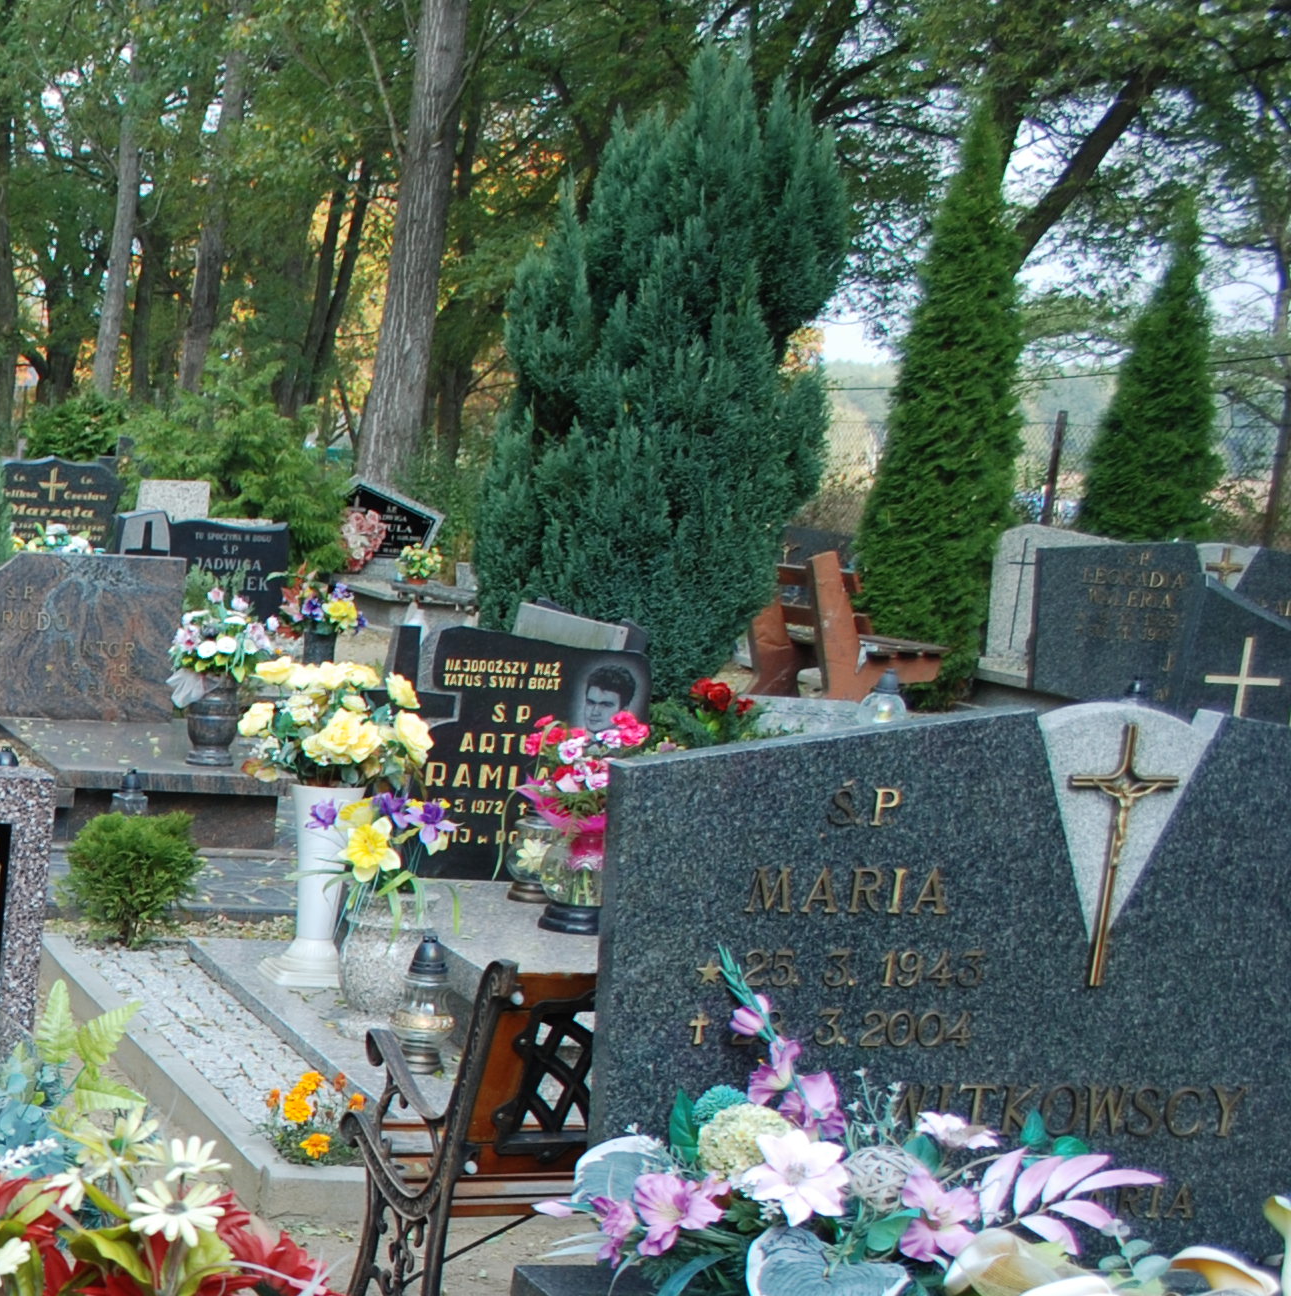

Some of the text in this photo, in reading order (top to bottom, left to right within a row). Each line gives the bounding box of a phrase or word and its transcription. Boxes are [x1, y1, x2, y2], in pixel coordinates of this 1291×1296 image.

[376, 514, 408, 523] ADWIGA
[527, 677, 563, 691] BRAT
[425, 761, 550, 791] RAMLA
[471, 799, 504, 815] 1972
[744, 866, 949, 916] MARIA
[880, 949, 986, 989] 1943
[859, 1009, 972, 1048] 2004
[896, 1084, 1248, 1139] WITKOWSCY
